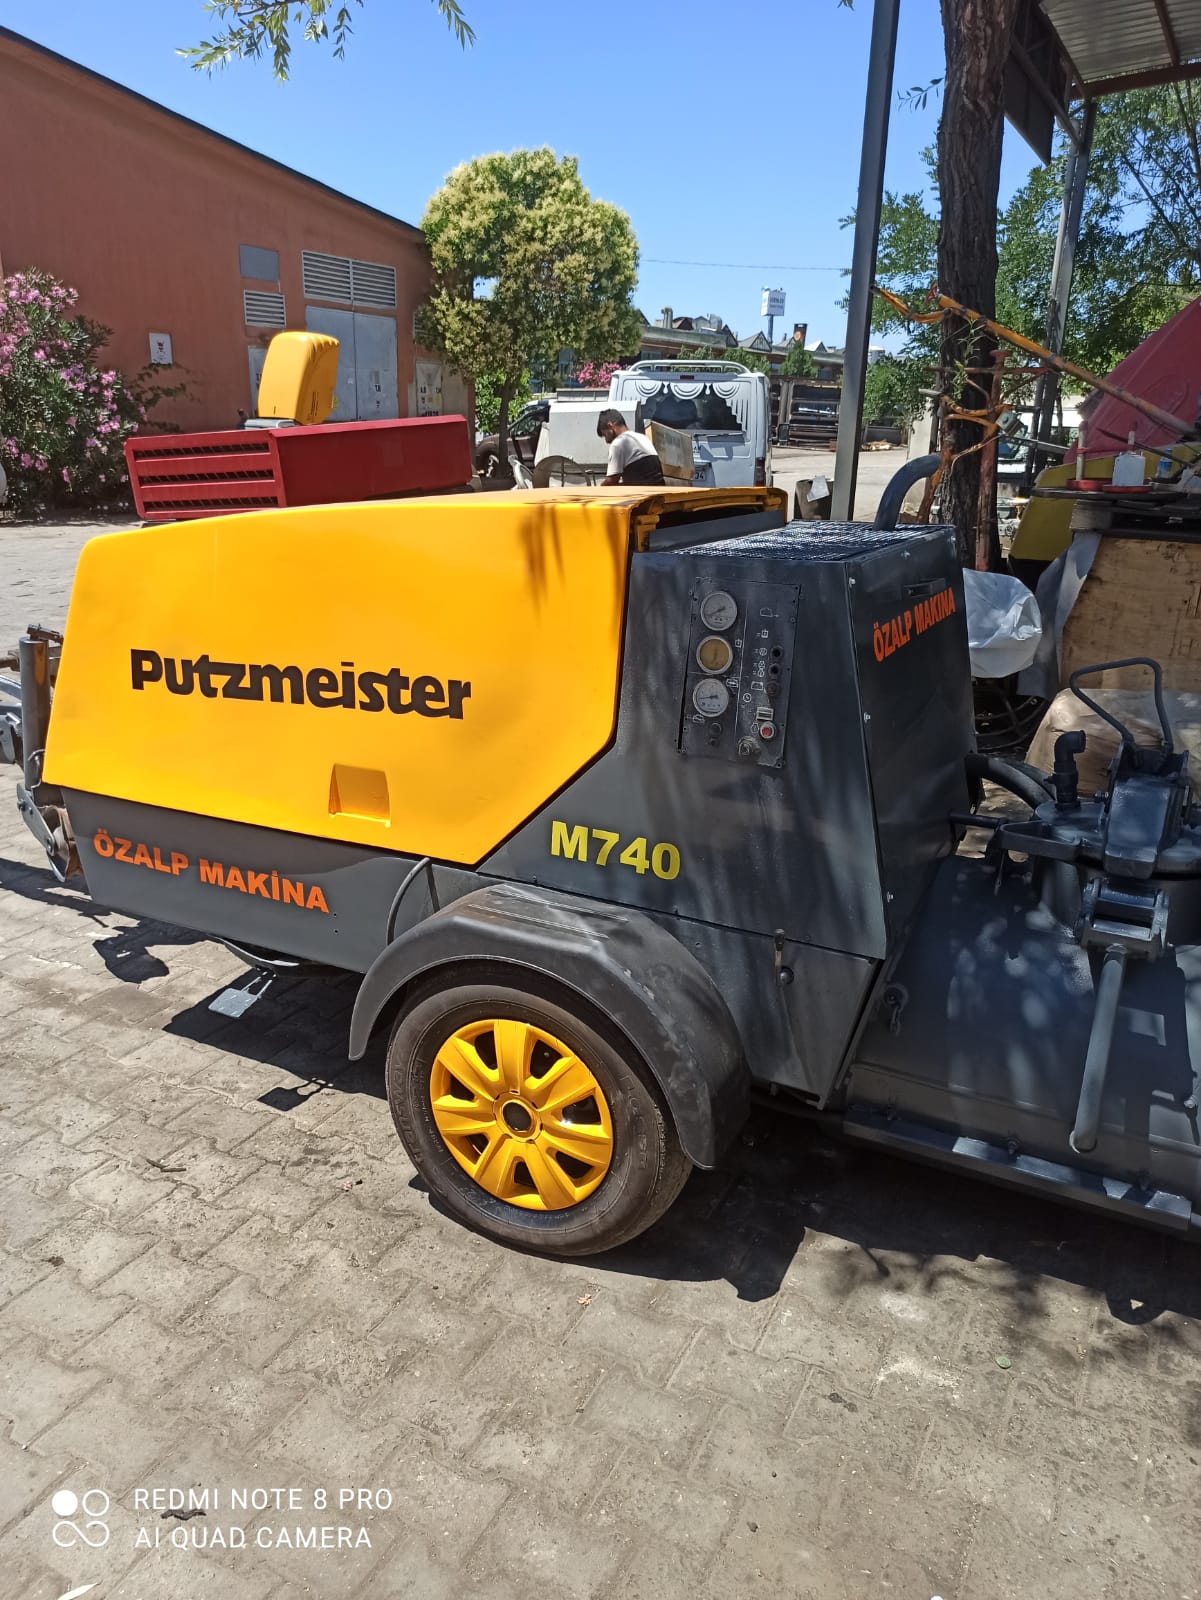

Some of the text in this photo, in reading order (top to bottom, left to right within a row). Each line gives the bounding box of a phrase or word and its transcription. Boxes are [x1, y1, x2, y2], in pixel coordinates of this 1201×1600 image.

[873, 610, 912, 662] ÖZALP
[130, 648, 472, 721] Putzmeister
[93, 828, 329, 914] ÖZALP MAKİNA
[550, 820, 681, 880] M740
